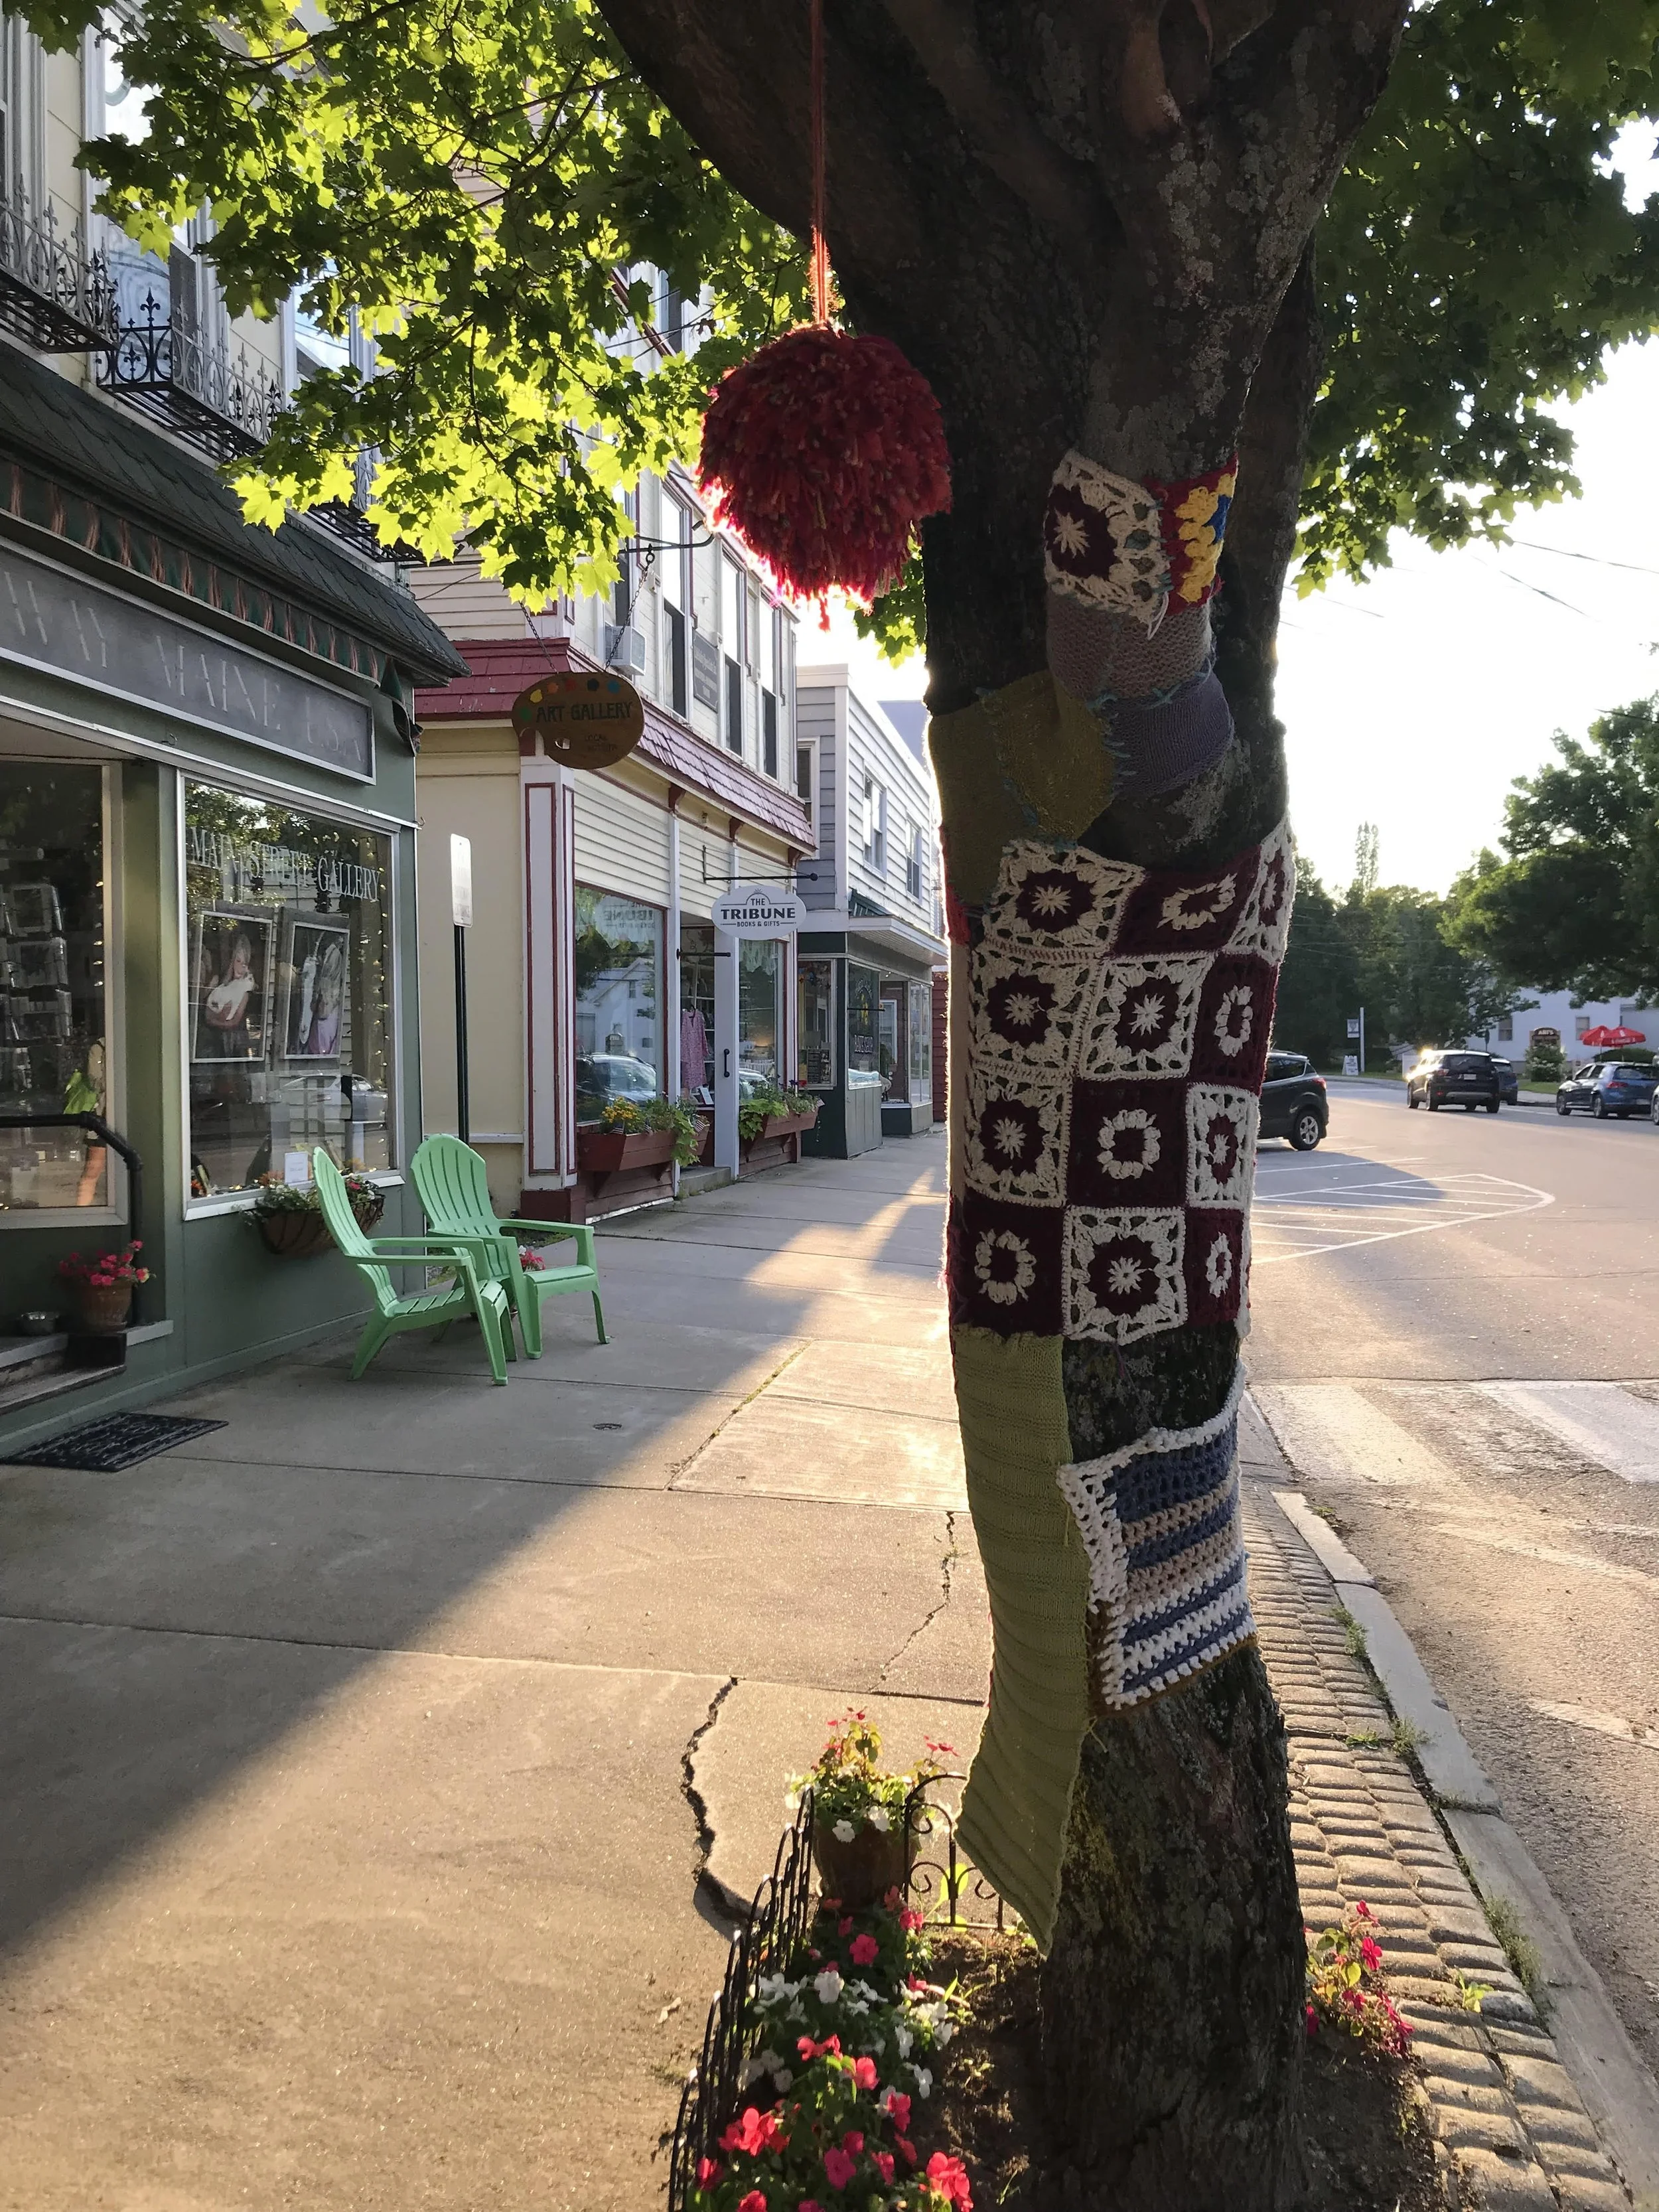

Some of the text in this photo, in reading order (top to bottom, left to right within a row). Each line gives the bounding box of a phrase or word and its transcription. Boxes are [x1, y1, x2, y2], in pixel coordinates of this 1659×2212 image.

[536, 701, 632, 723] ART GALLERY
[317, 857, 380, 903] GALLERY
[721, 907, 796, 920] TRIBUNE
